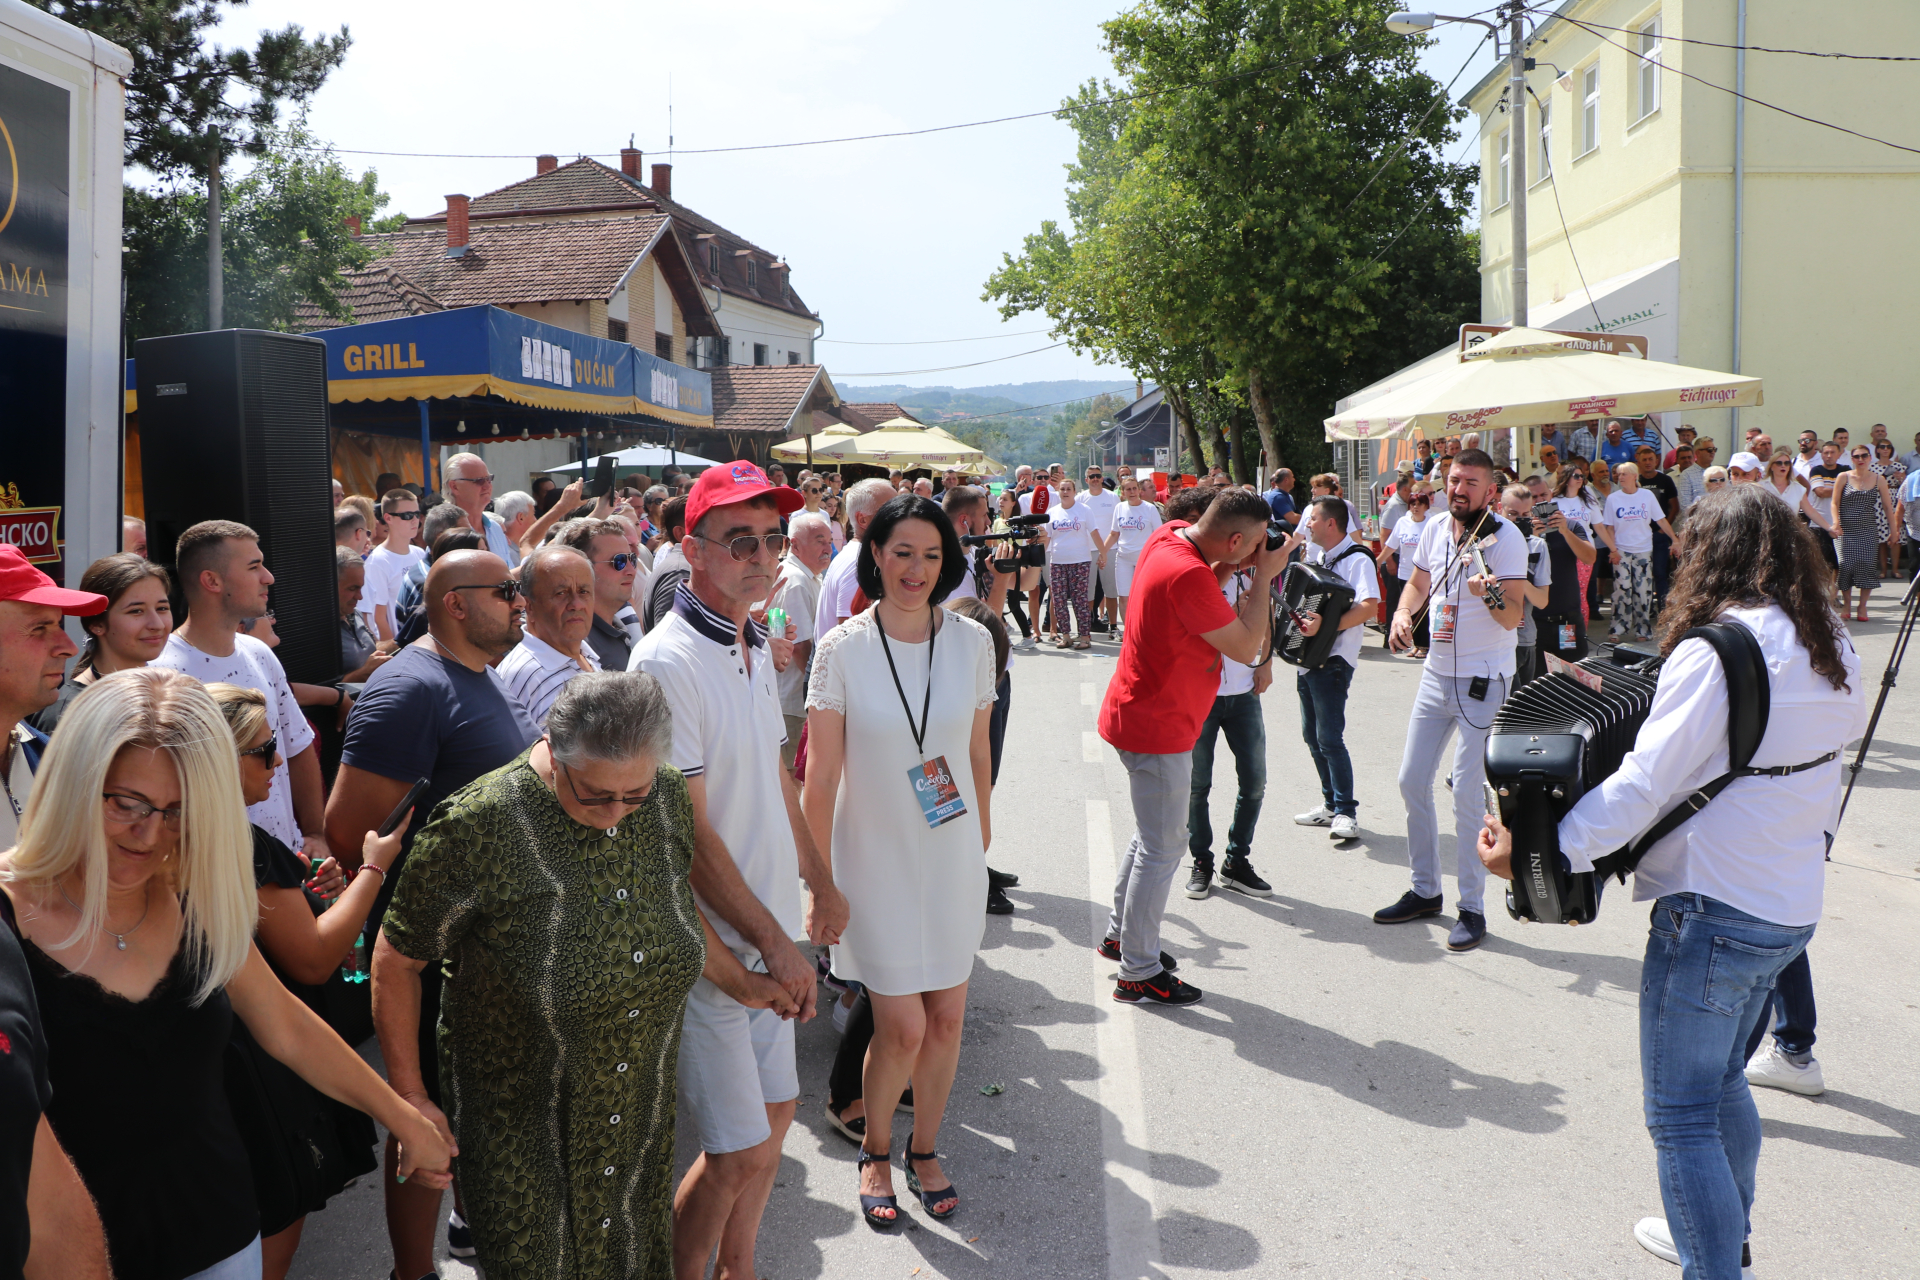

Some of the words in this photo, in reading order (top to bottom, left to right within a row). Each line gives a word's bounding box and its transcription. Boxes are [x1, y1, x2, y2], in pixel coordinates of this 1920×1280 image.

[343, 342, 425, 372] GRILL
[575, 354, 615, 388] DUĆAN
[1679, 387, 1738, 404] Eichinger
[1037, 490, 1046, 510] PRVA
[936, 804, 954, 817] PRESS
[1530, 852, 1548, 899] GUERRINI
